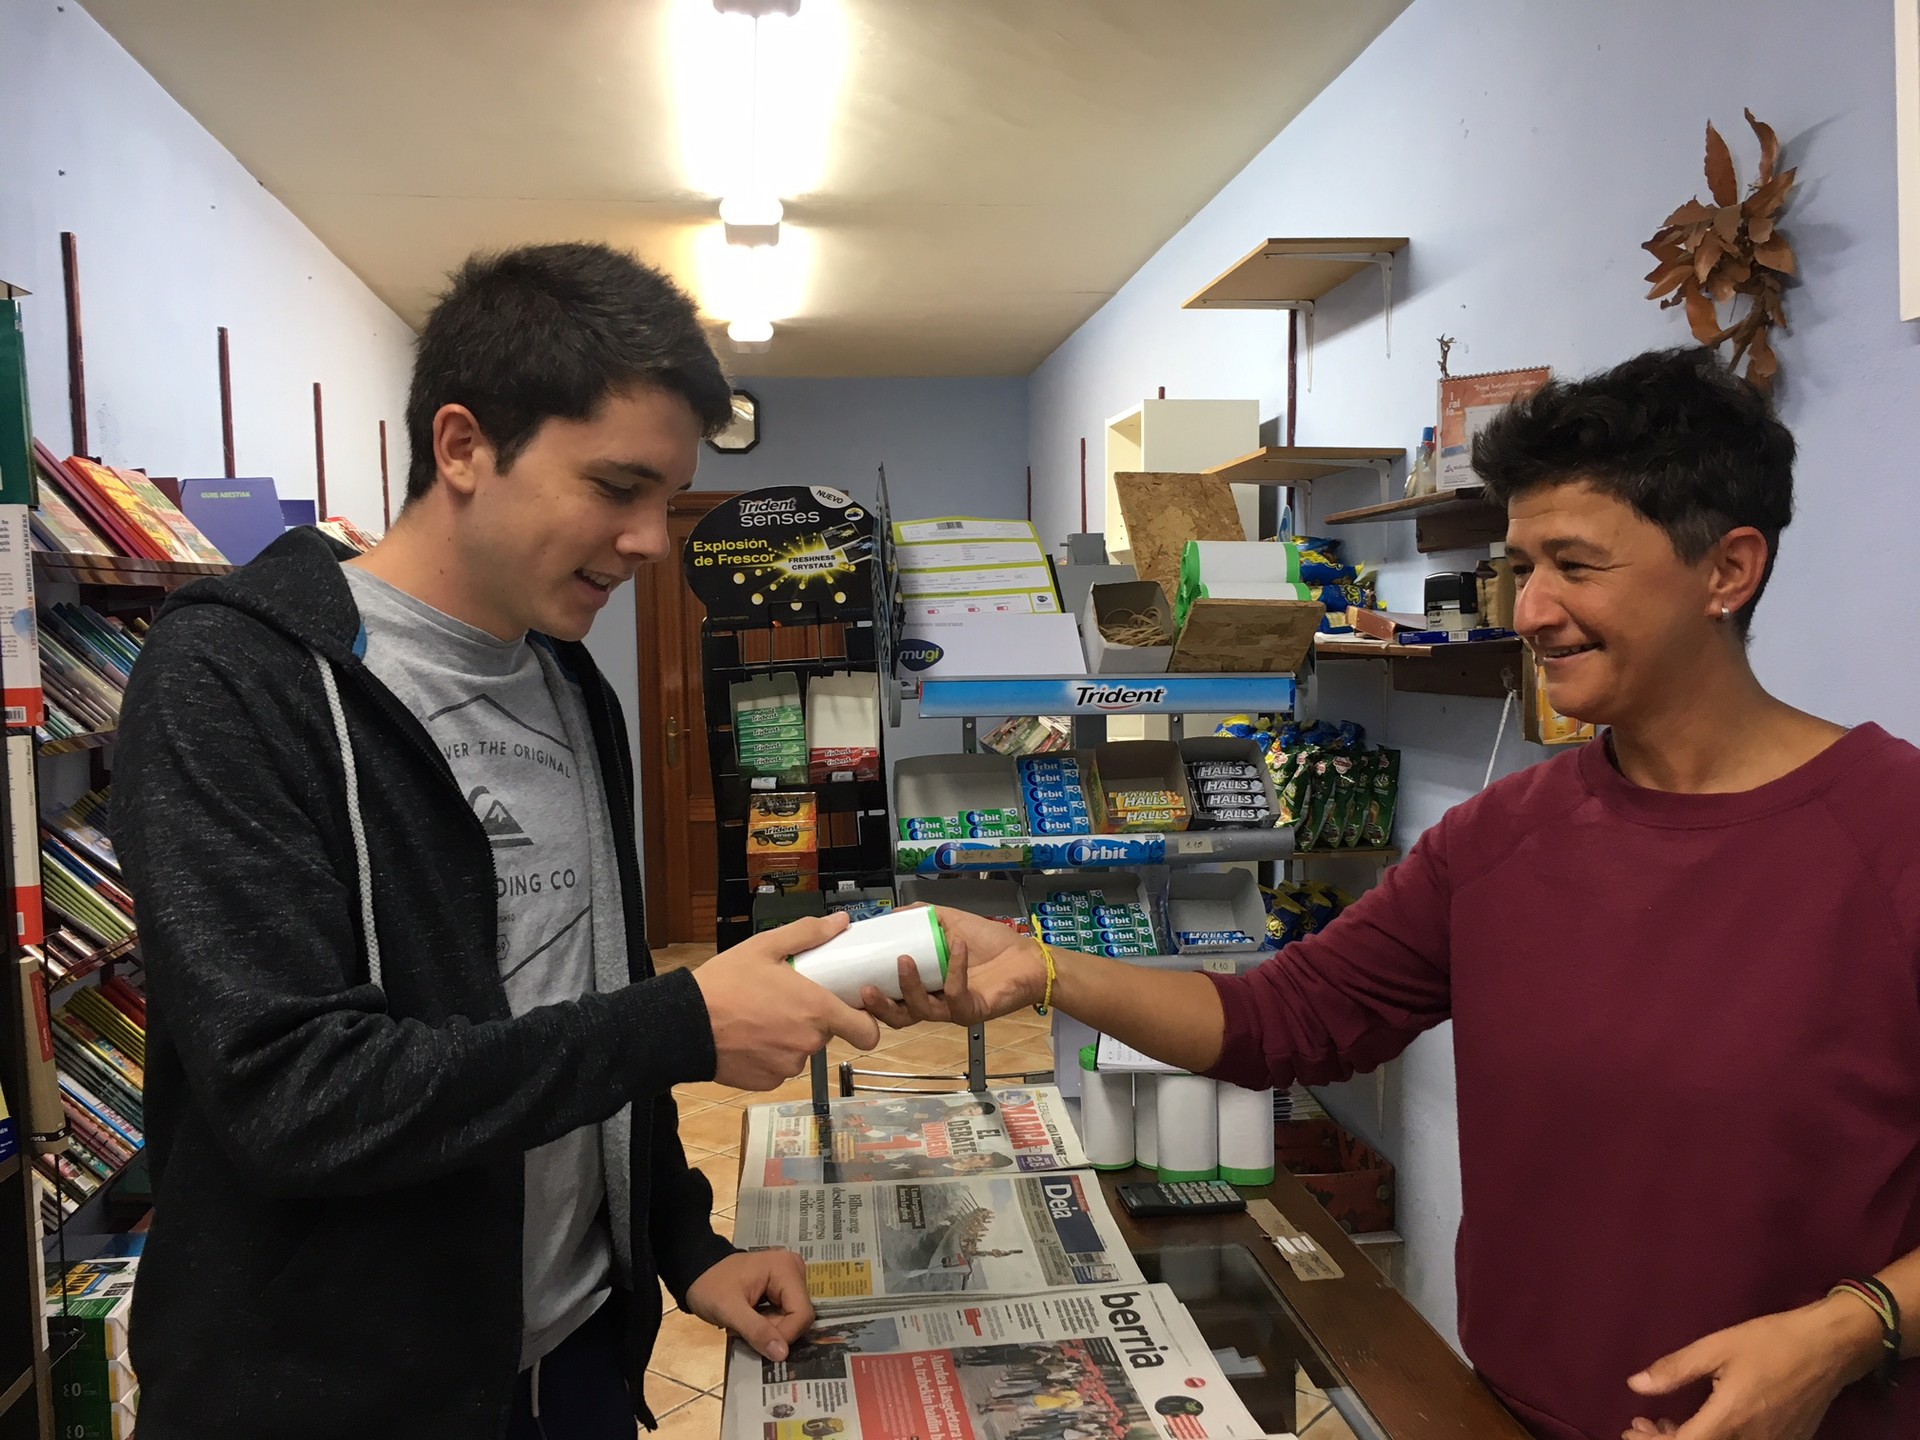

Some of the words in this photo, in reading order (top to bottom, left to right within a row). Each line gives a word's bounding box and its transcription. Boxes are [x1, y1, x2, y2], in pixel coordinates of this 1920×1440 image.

[816, 489, 844, 504] NUEVO
[740, 498, 795, 514] Trident
[740, 510, 820, 527] senses
[693, 538, 768, 554] Explosión
[694, 554, 713, 567] de
[718, 551, 775, 565] Frescor
[788, 554, 836, 564] FRESHNESS
[791, 562, 834, 571] CRYSTALS
[899, 647, 940, 663] mugi
[1075, 686, 1163, 707] Trident
[751, 712, 779, 722] Trident
[752, 726, 780, 736] Trident
[753, 742, 781, 751] Trident
[824, 748, 851, 757] Trident
[479, 741, 507, 756] THE
[514, 743, 571, 779] ORIGINAL
[753, 755, 782, 765] Trident
[825, 757, 851, 766] Trident
[1200, 766, 1243, 776] HALLS
[1030, 772, 1061, 784] Orbit
[1207, 780, 1249, 791] HALLS
[1033, 788, 1063, 800] Orbit
[1210, 794, 1252, 805] HALLS
[1124, 795, 1168, 808] HALLS
[1037, 803, 1068, 815] Orbit
[1214, 809, 1255, 820] HALLS
[968, 812, 1001, 824] Orbit
[1126, 809, 1170, 822] HALLS
[908, 819, 940, 829] Orbit
[1040, 819, 1072, 831] Orbit
[764, 826, 799, 835] Trident
[910, 829, 944, 839] Orbit
[971, 827, 1004, 838] Orbit
[1069, 841, 1129, 865] Orbit
[550, 868, 576, 891] CO
[1041, 903, 1072, 914] Orbit
[1095, 906, 1126, 916] Orbit
[1044, 918, 1074, 928] Orbit
[1099, 916, 1131, 926] Orbit
[1045, 933, 1077, 943] Orbit
[1103, 932, 1135, 942] Orbit
[1108, 946, 1140, 956] Orbit
[1000, 1101, 1050, 1149] MARCA
[947, 1119, 977, 1155] DEBATE
[976, 1129, 1001, 1139] EL
[799, 1190, 815, 1217] médico
[813, 1190, 826, 1213] mayor
[832, 1188, 845, 1208] desde
[1044, 1184, 1078, 1219] Deia
[848, 1194, 863, 1217] Bilbao
[1100, 1291, 1165, 1369] berria
[930, 1354, 949, 1385] Alardea
[915, 1369, 933, 1405] trabekin
[938, 1386, 962, 1437] ikasgeletara
